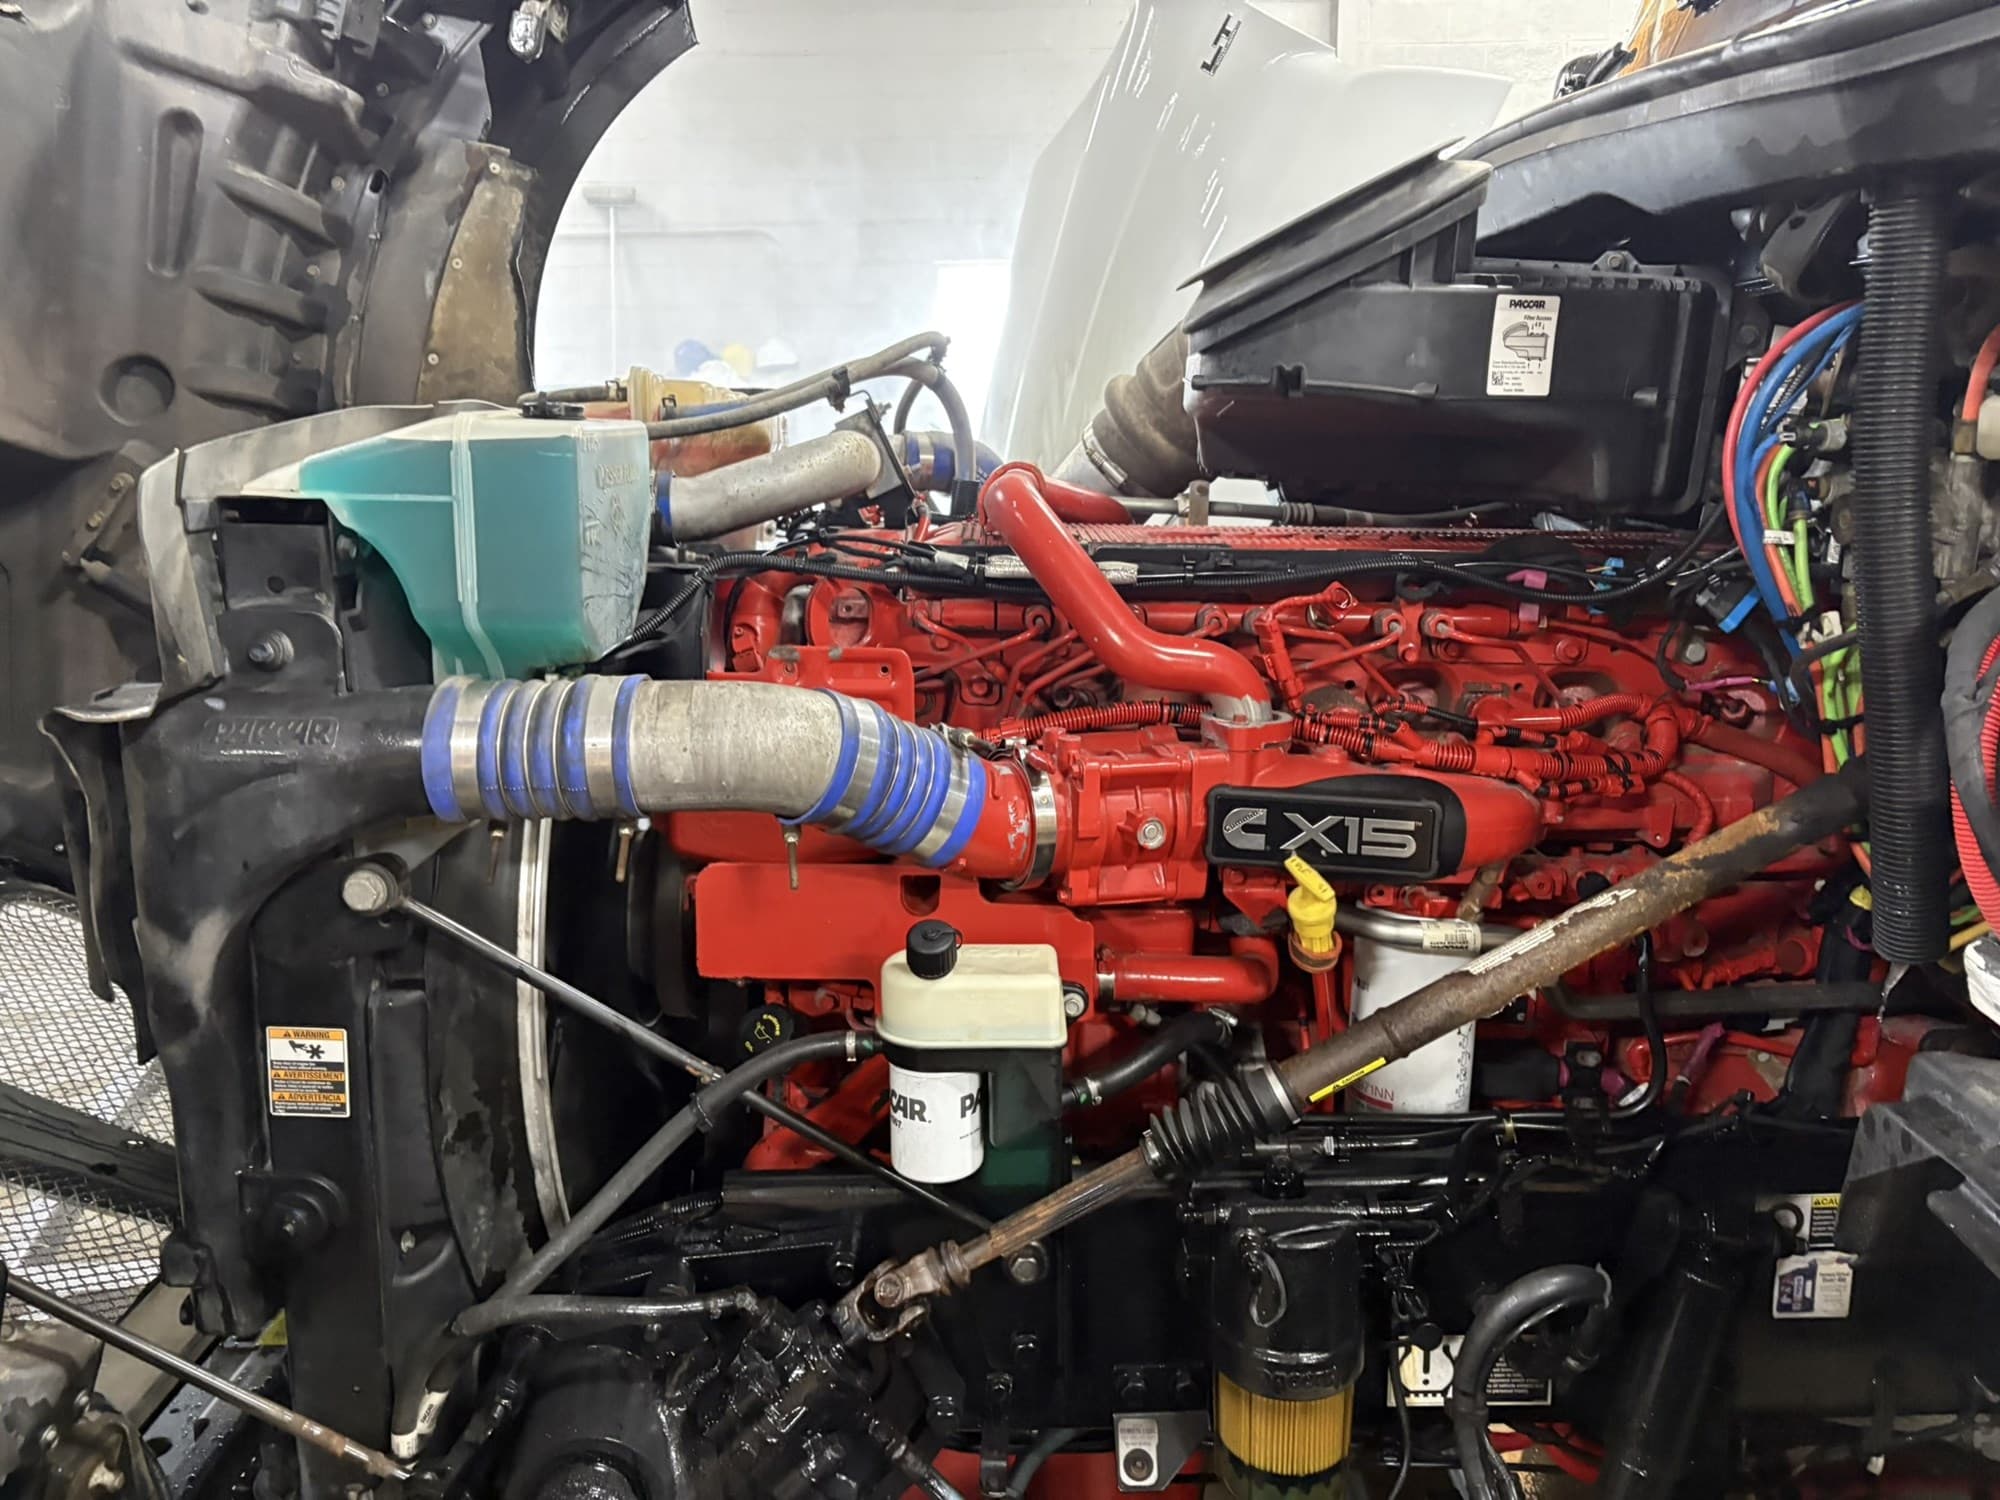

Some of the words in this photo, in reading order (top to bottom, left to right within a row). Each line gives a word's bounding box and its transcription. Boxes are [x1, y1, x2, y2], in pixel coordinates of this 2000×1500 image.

[1509, 299, 1546, 309] PACCAR
[1279, 812, 1418, 859] X15
[293, 1031, 330, 1039] WARNING
[283, 1071, 343, 1080] AVERTISSEMENT
[288, 1093, 341, 1101] ADVERTENCIA
